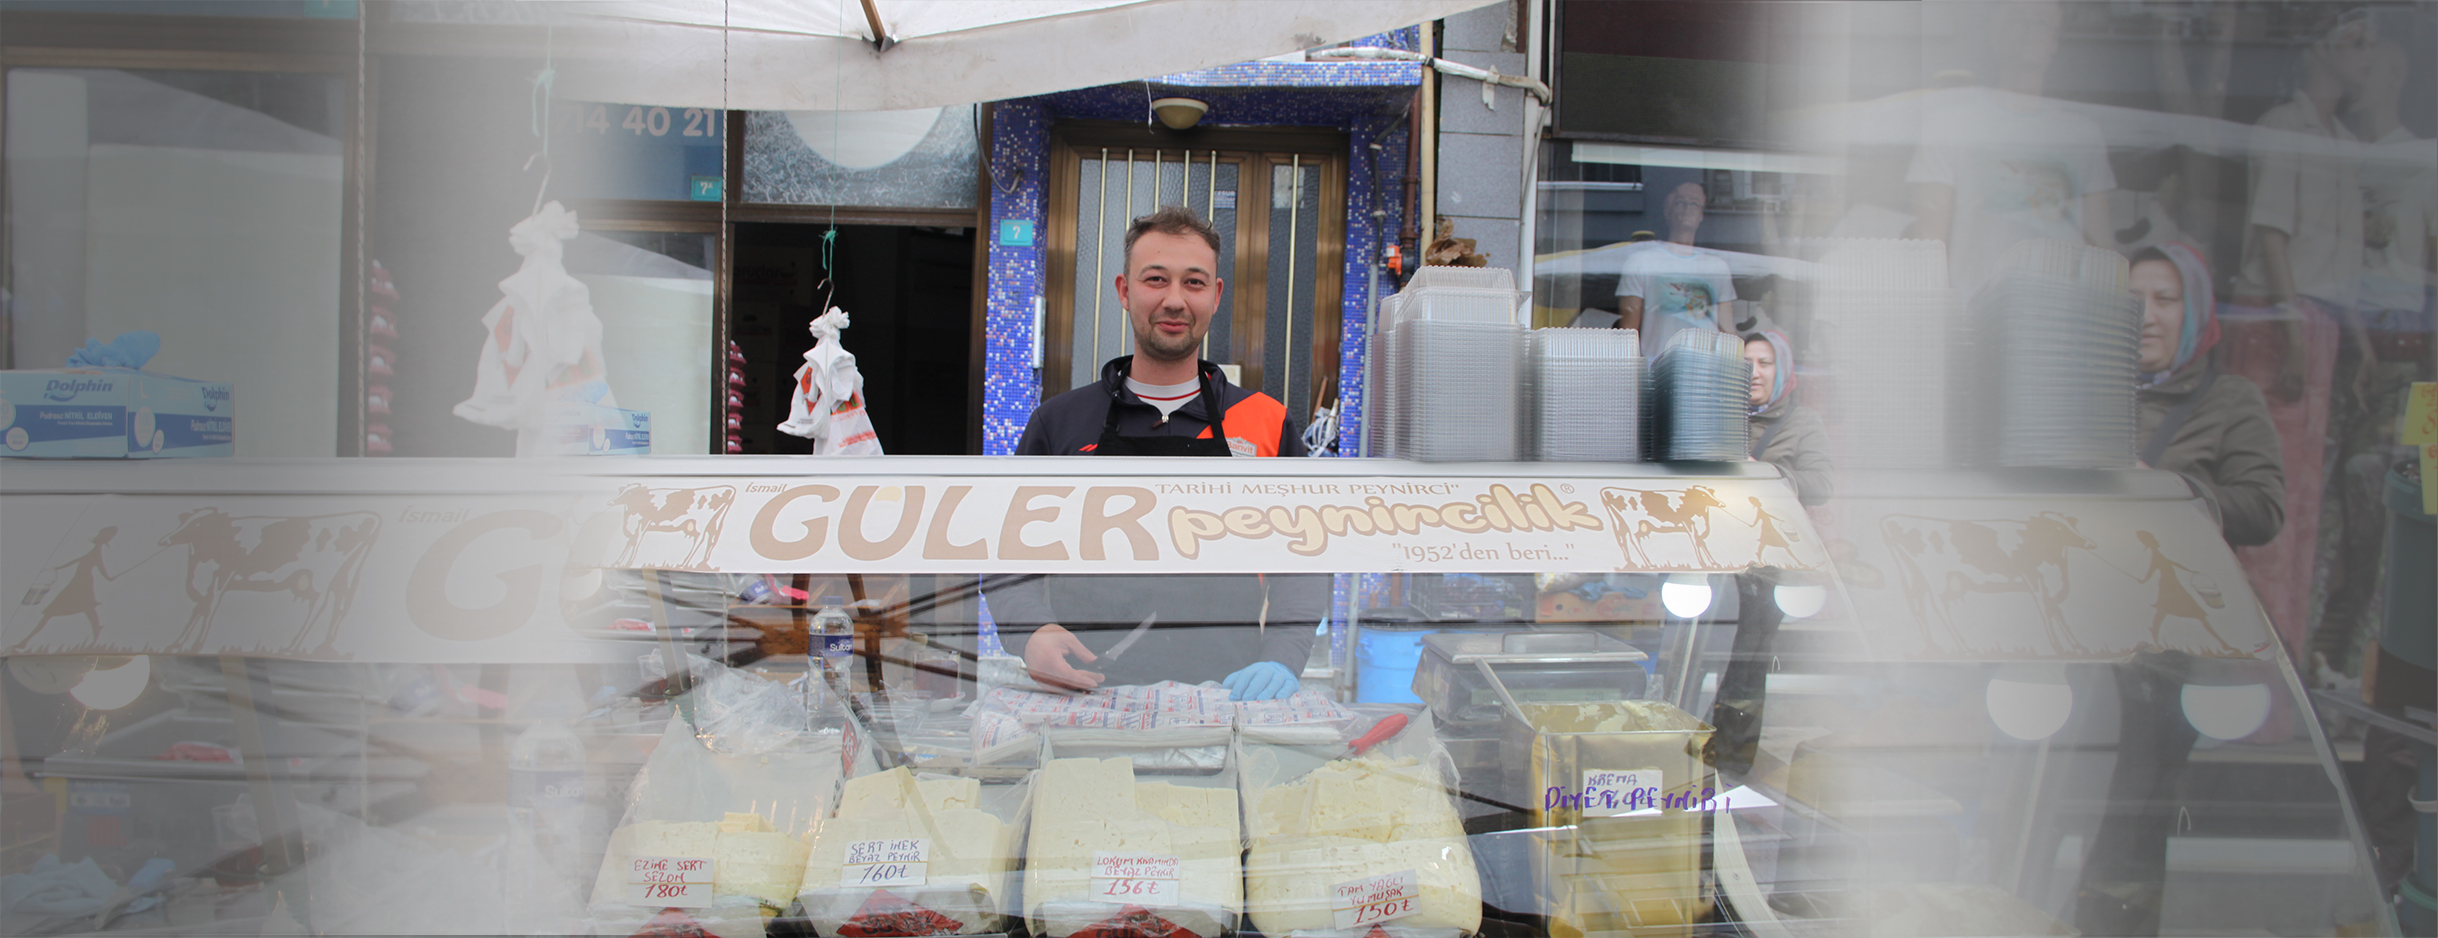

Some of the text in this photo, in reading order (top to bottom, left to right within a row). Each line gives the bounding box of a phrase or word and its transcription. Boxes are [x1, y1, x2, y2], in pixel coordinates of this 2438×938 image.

[622, 106, 671, 137] 40
[683, 108, 715, 137] 21
[1012, 225, 1021, 240] 7
[46, 379, 113, 394] Dolphin
[202, 386, 230, 401] Dolphin
[1155, 482, 1232, 495] TARİHİ
[1242, 484, 1339, 498] MEŞHUR
[1168, 483, 1604, 561] peynircilik
[1588, 773, 1638, 786] KREMA
[545, 785, 584, 799] Sultan
[851, 840, 884, 856] SERT
[849, 850, 920, 864] BEYAZ PEYNİR
[1097, 856, 1133, 867] LOKUM
[677, 860, 707, 871] SERT
[1105, 865, 1141, 877] BEYAZ
[644, 870, 686, 883] SEZON
[1337, 874, 1403, 897] TAM YAĞLI
[1349, 886, 1403, 905] YUMUŞAK
